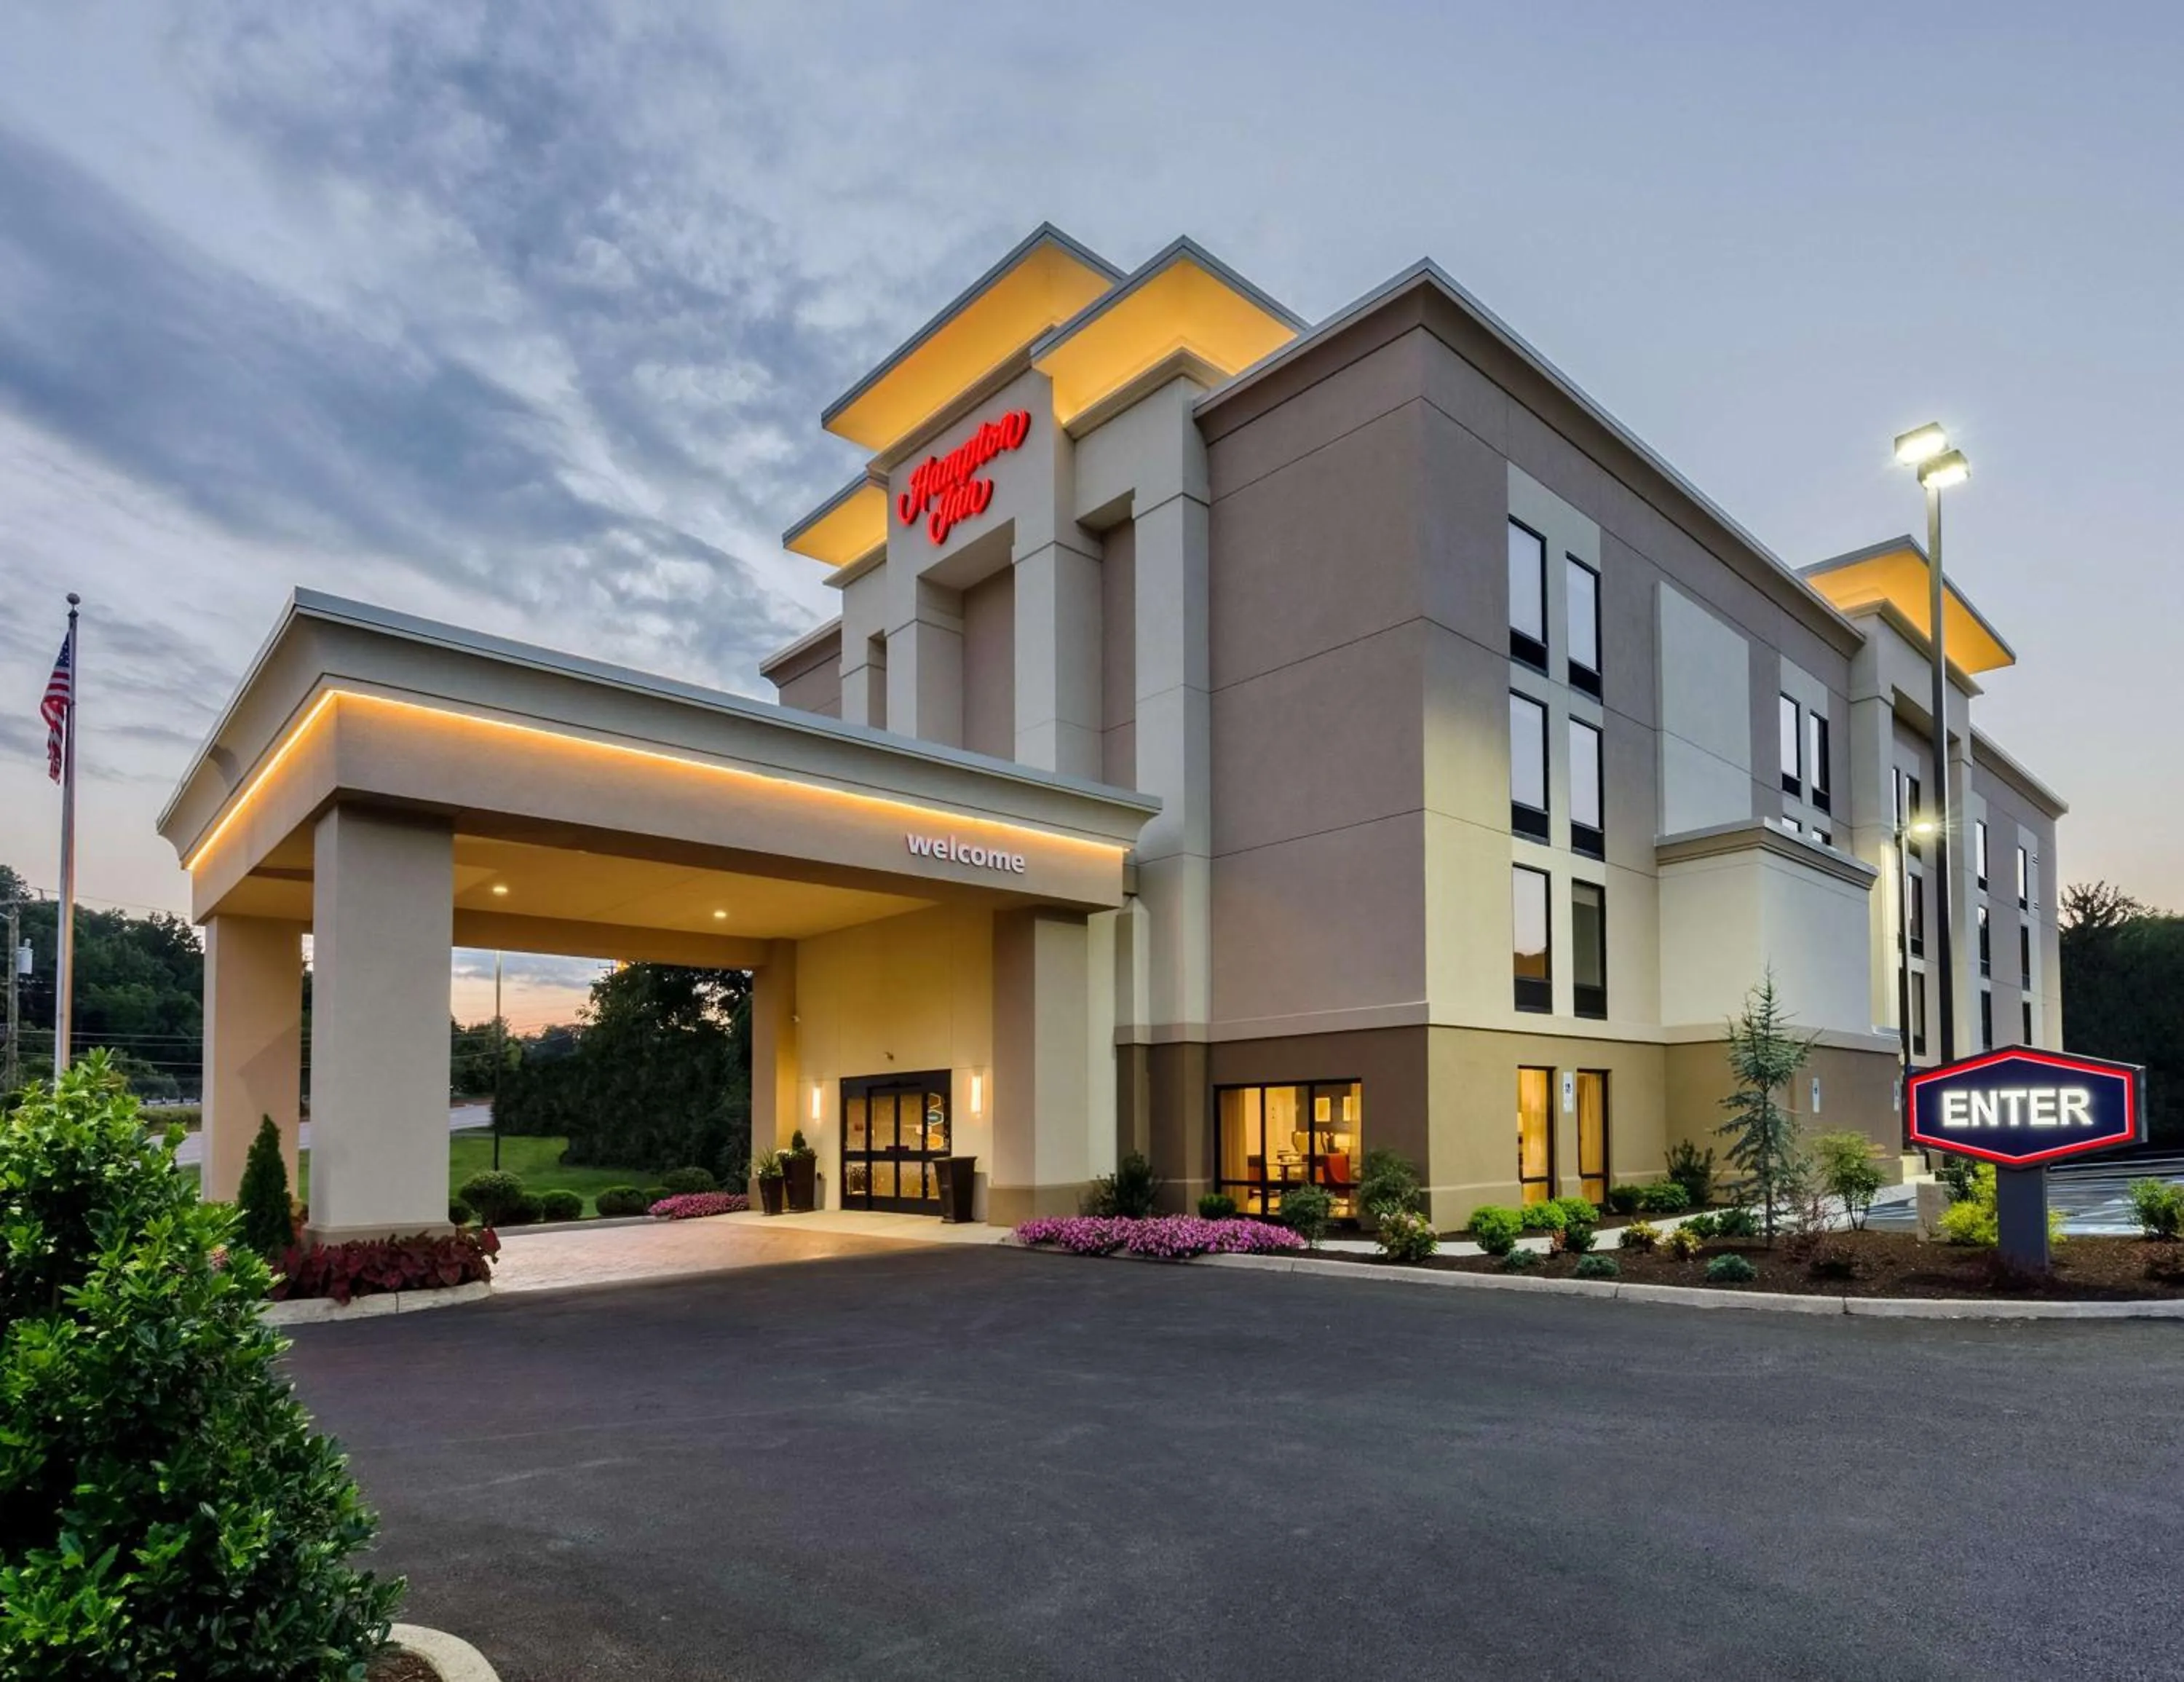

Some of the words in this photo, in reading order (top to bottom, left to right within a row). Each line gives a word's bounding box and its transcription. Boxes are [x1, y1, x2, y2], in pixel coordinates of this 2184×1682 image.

[898, 410, 1031, 525] Hampton
[929, 478, 994, 544] Inn
[906, 833, 1026, 873] welcome
[1942, 1089, 2093, 1126] ENTER
